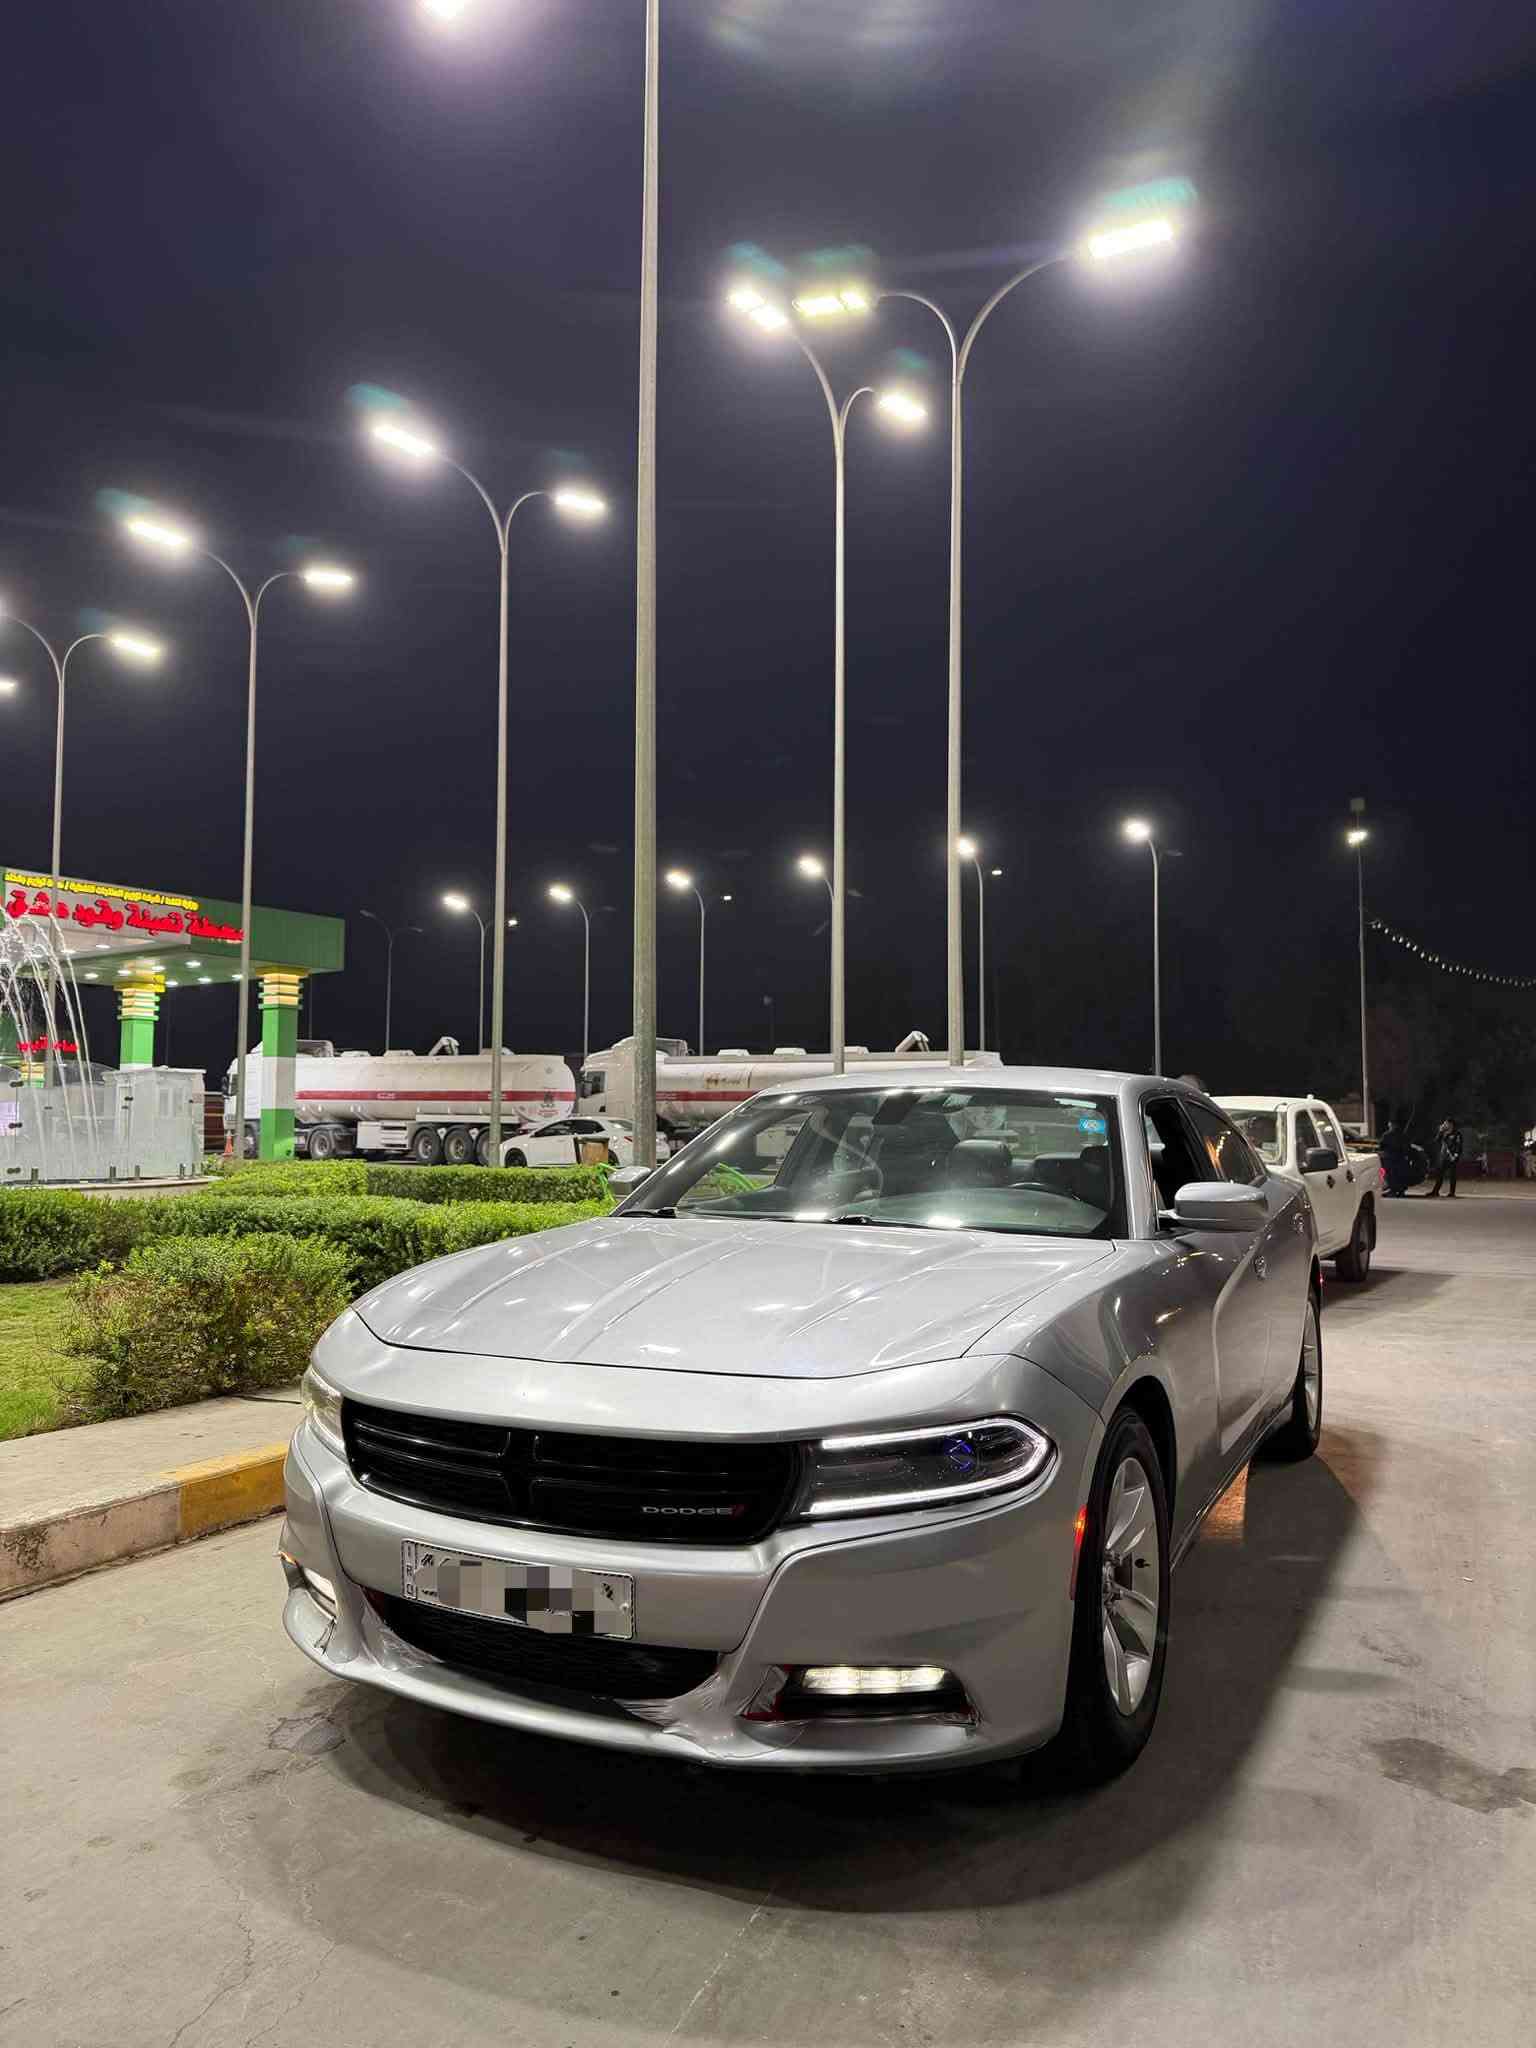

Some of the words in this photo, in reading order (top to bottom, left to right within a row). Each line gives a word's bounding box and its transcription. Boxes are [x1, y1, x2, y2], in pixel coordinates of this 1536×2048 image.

[6, 889, 69, 918] دشق
[72, 899, 124, 930] وقود
[125, 902, 185, 936] تعبئة
[184, 911, 244, 942] محطة
[642, 1506, 733, 1515] DODGE
